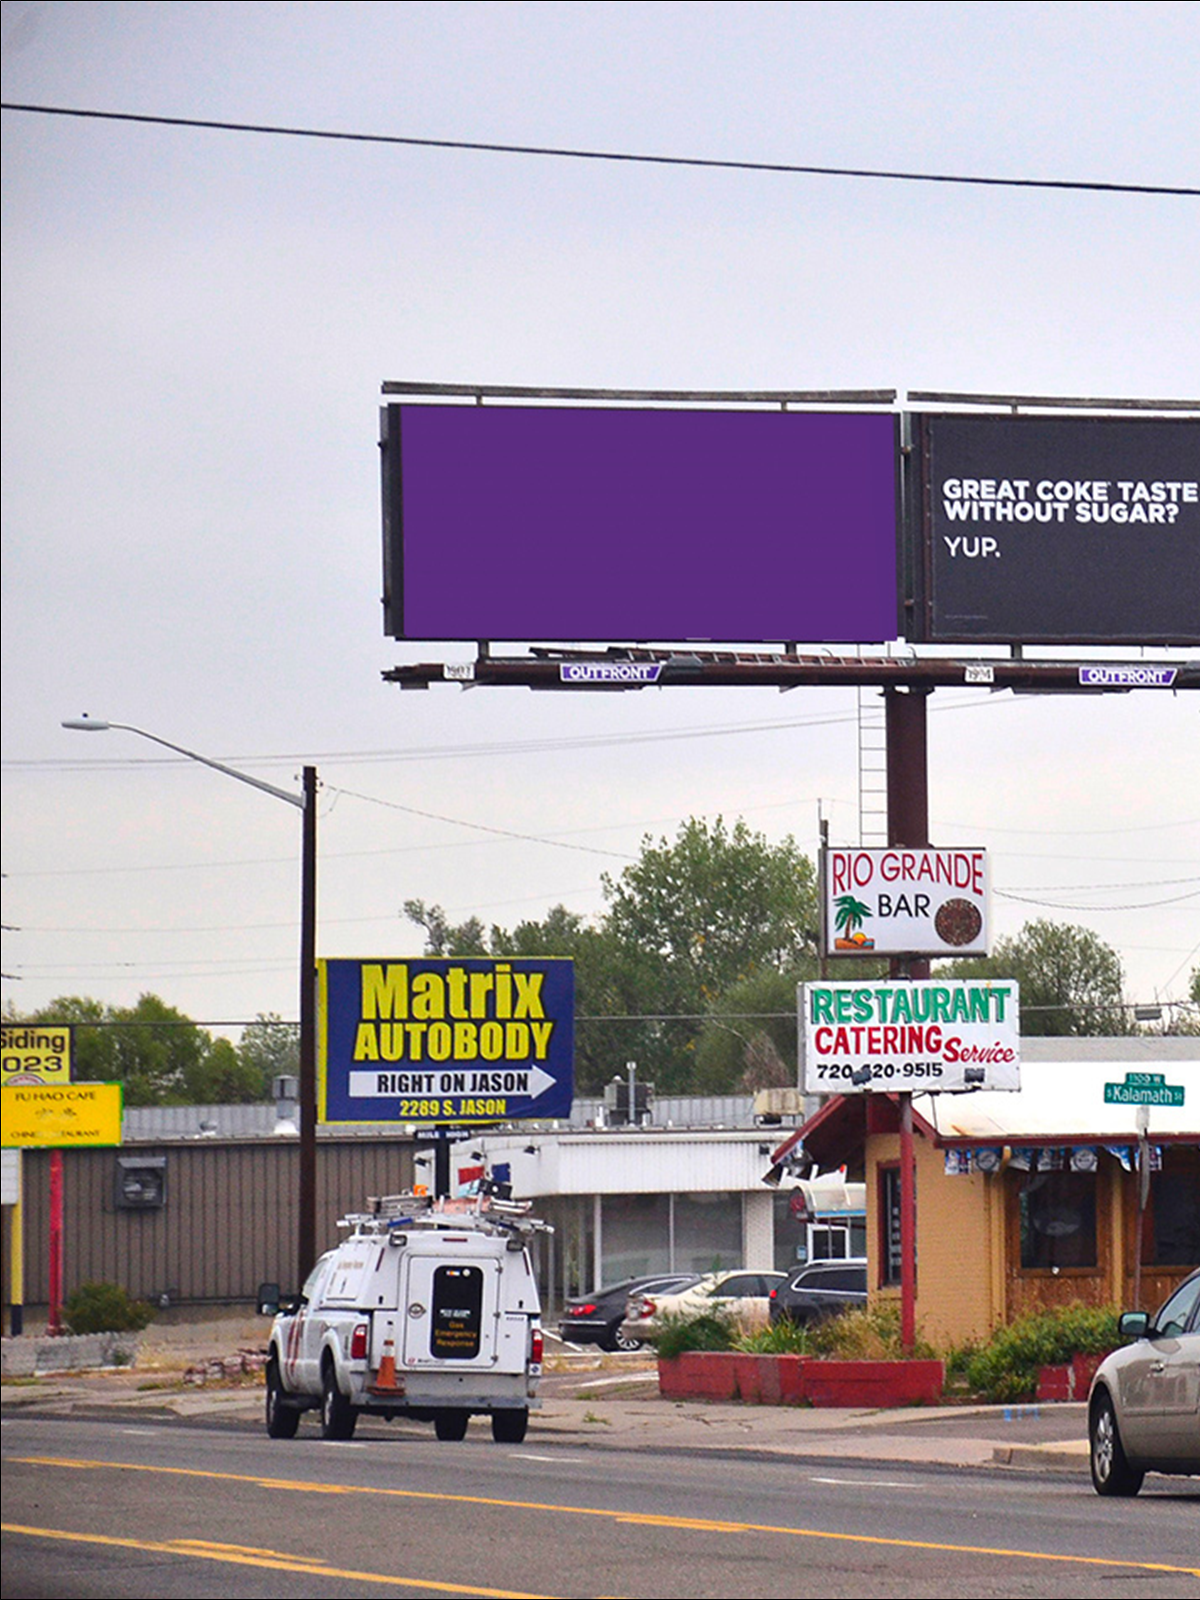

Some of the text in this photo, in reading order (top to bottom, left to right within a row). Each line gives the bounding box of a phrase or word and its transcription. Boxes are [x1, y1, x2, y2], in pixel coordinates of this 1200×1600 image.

[943, 479, 1199, 502] GREAT COKE TASTE
[944, 500, 1180, 524] WITHOUT SUGAR?
[944, 536, 1001, 558] YUP.
[569, 666, 650, 679] OUTFRONT
[1087, 669, 1167, 682] OUTFRONT
[833, 853, 984, 896] RIO GRANDE
[878, 894, 931, 918] BAR
[361, 964, 545, 1020] Matrix
[811, 987, 1011, 1024] RESTAURANT
[353, 1021, 553, 1061] AUTOBODY
[815, 1026, 1015, 1063] CATERING Service
[377, 1073, 529, 1093] RIGHT ON JASON
[1113, 1086, 1173, 1103] Kalamath
[400, 1099, 507, 1116] 2289 S. JASON
[435, 1330, 477, 1339] Emergency
